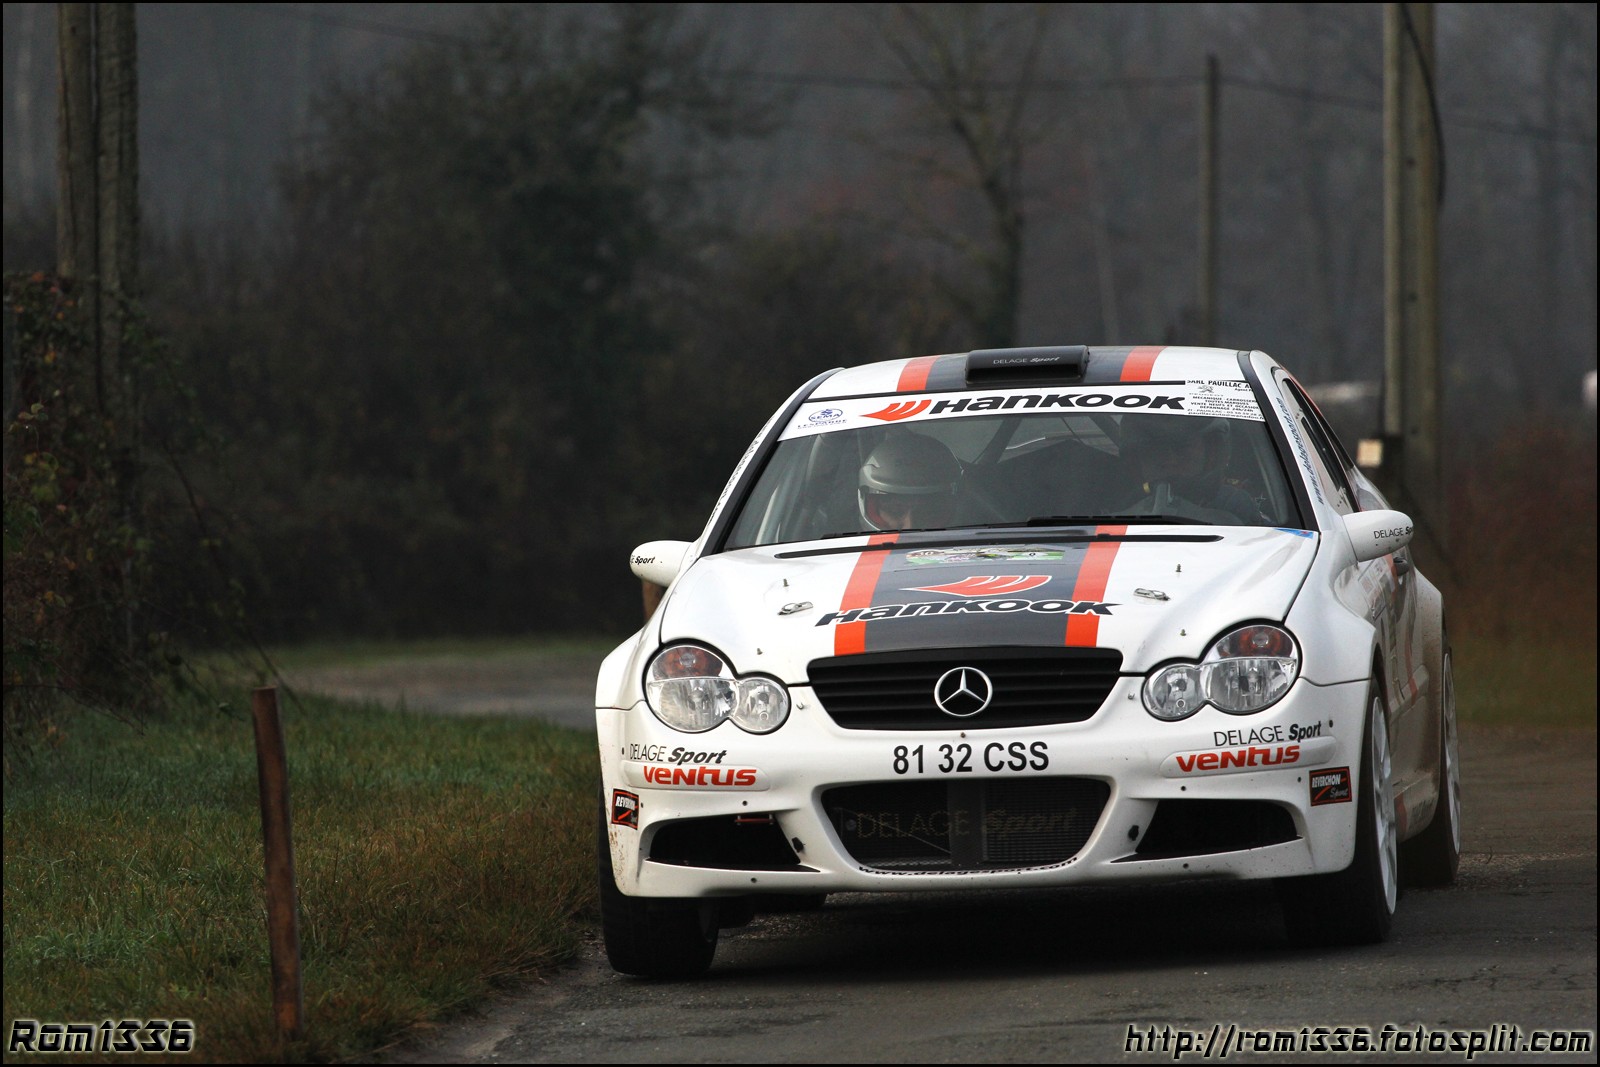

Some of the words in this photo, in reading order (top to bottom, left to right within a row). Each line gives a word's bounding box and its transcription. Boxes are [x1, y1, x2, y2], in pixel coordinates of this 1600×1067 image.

[1208, 380, 1242, 388] PAUILLAC
[1374, 528, 1404, 539] DELAGE
[635, 556, 656, 565] Sport
[1214, 725, 1284, 747] DELAGE
[1288, 721, 1322, 743] Sport
[629, 744, 667, 762] DELAGE
[668, 747, 727, 765] Sport
[893, 744, 925, 774] 81
[938, 743, 973, 773] 32
[983, 741, 1049, 772] CSS
[1311, 774, 1341, 788] REVERCHON
[855, 810, 970, 839] DELAGE
[983, 807, 1079, 840] Sport
